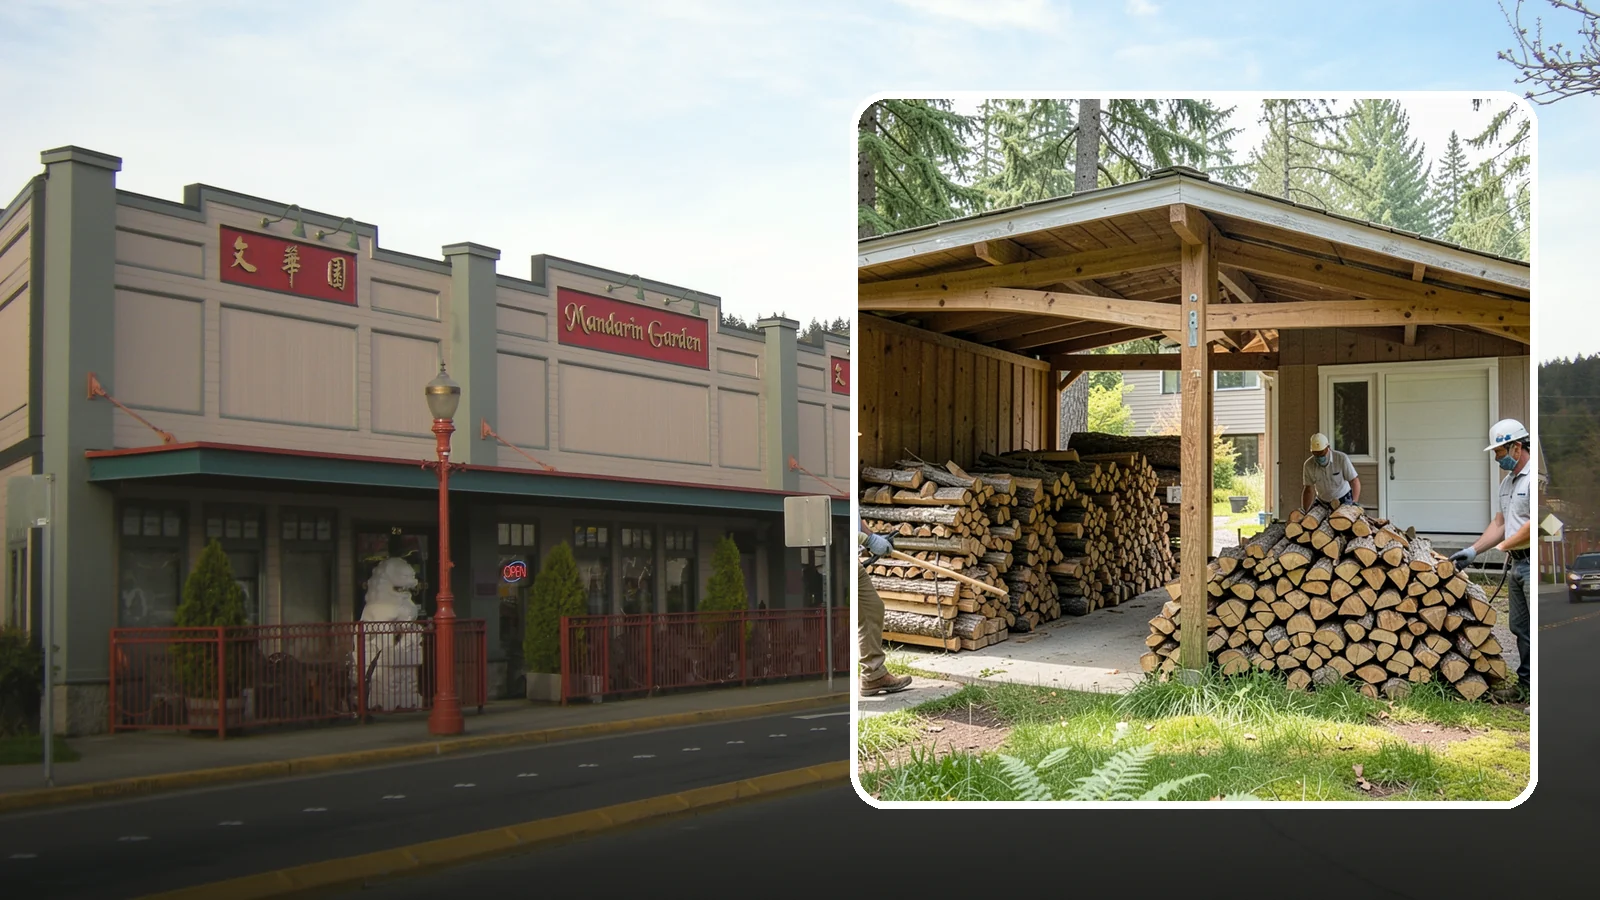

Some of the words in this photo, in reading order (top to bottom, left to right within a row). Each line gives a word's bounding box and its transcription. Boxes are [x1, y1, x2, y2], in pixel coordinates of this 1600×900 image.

[230, 235, 346, 291] 文華園
[564, 302, 643, 341] Mandarin
[648, 320, 701, 352] Garden
[503, 565, 527, 578] OPEN
